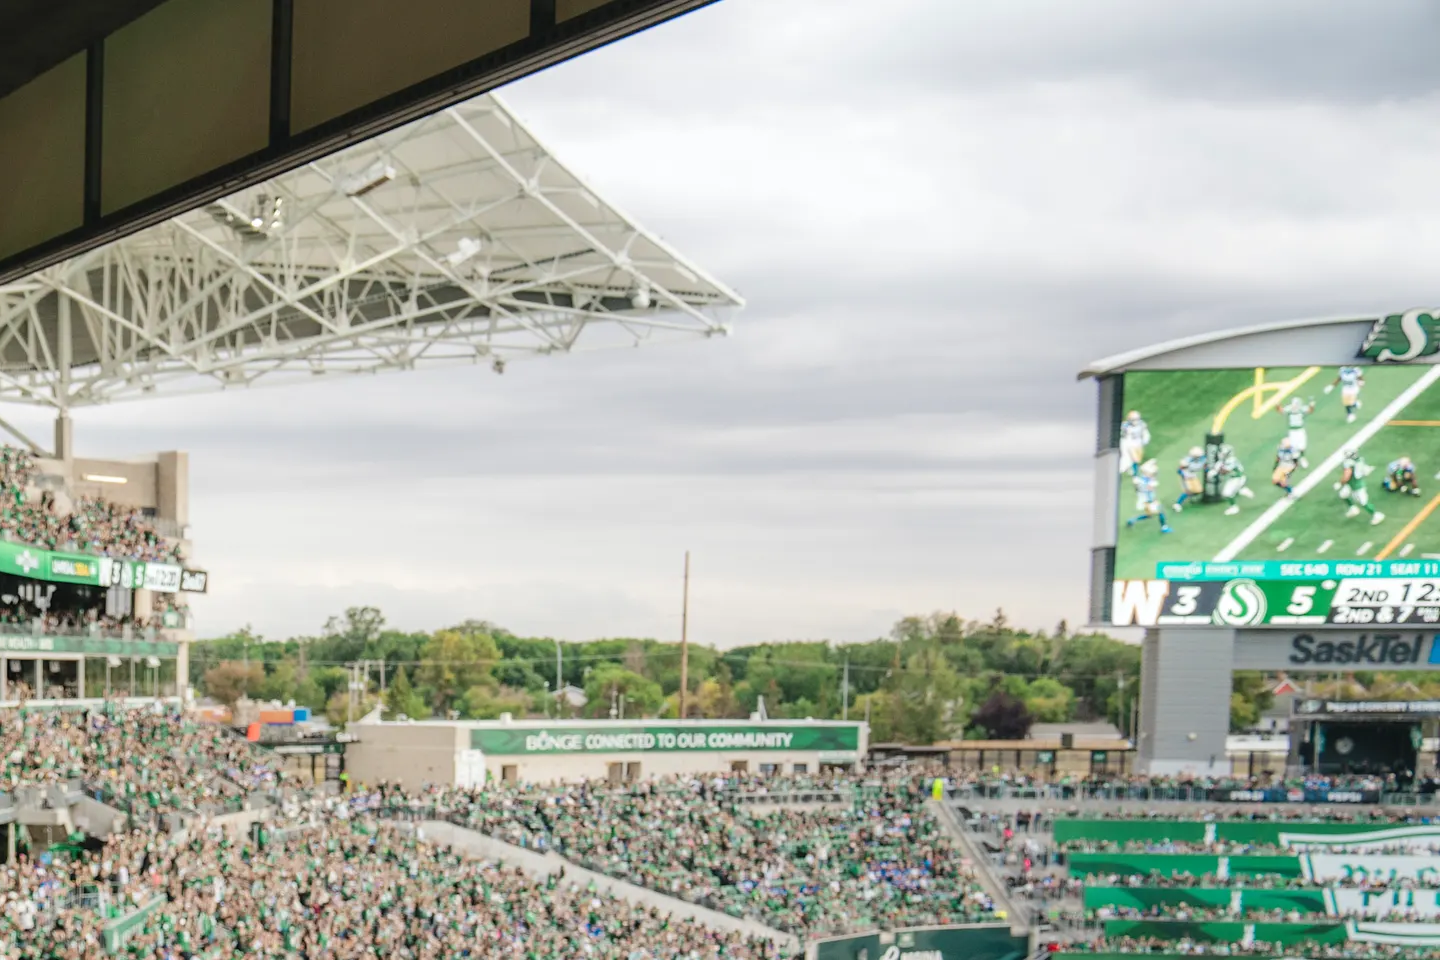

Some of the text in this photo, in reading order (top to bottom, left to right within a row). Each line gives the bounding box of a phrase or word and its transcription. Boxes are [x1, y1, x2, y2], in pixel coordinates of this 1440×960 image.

[1171, 586, 1202, 616] 3
[1286, 586, 1317, 616] 5
[1347, 588, 1389, 603] 2ND
[1333, 606, 1374, 624] 2ND
[1396, 606, 1415, 624] 7
[1288, 633, 1424, 665] SaskTel
[585, 733, 656, 749] CONNECTED
[657, 733, 676, 748] TO
[677, 733, 707, 748] OUR
[708, 733, 793, 748] COMMUNITY
